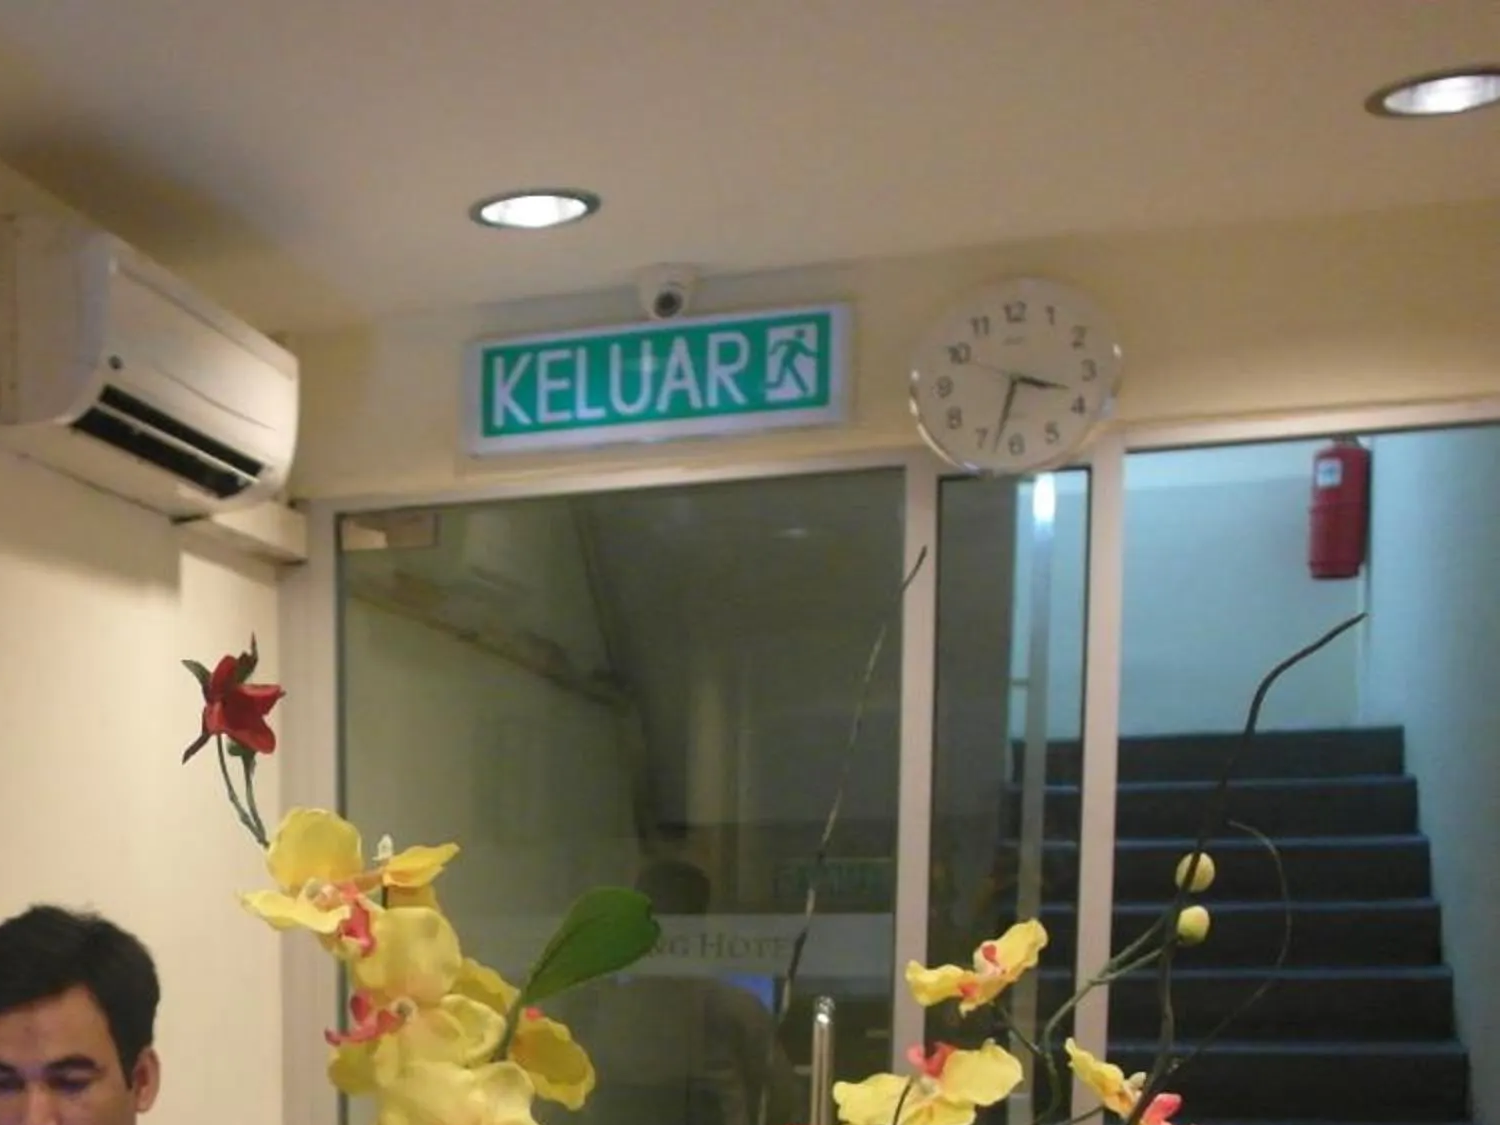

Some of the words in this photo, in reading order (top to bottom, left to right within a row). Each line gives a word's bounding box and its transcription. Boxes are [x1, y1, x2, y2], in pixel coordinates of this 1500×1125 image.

[1004, 301, 1026, 324] 12
[1045, 305, 1055, 326] 1
[971, 315, 990, 337] 11
[1070, 325, 1087, 349] 2
[949, 342, 971, 365] 10
[492, 331, 750, 426] KELUAR
[1081, 358, 1097, 382] 3
[935, 376, 954, 399] 9
[1070, 393, 1086, 416] 4
[947, 406, 963, 430] 8
[976, 427, 989, 449] 7
[1045, 420, 1060, 444] 5
[1008, 433, 1026, 456] 6
[700, 932, 792, 959] HOTE
